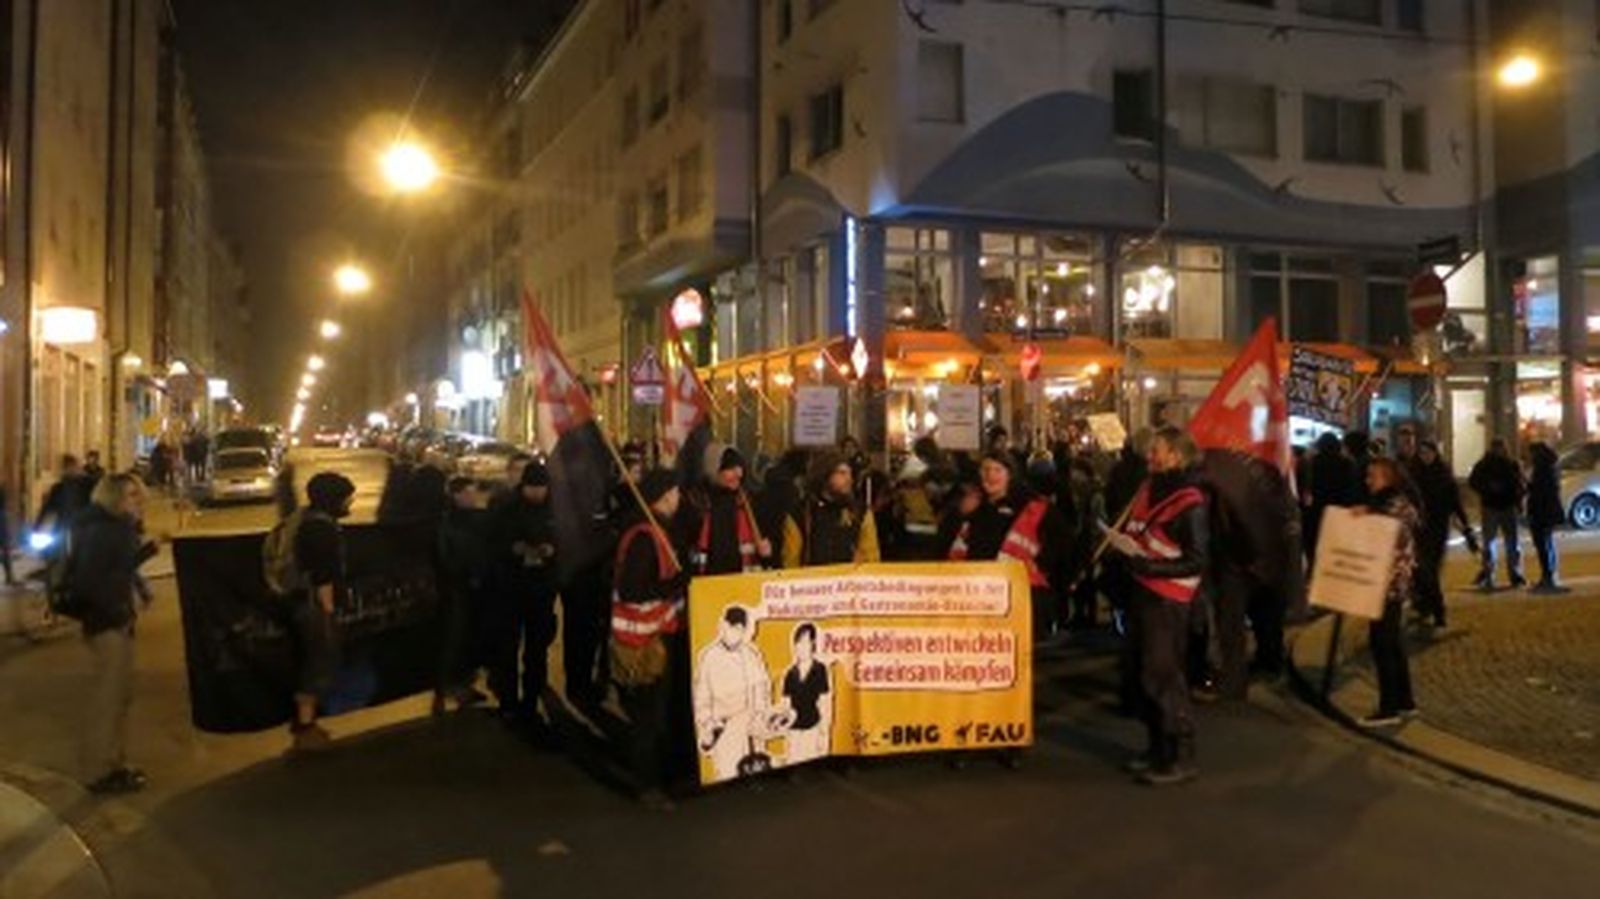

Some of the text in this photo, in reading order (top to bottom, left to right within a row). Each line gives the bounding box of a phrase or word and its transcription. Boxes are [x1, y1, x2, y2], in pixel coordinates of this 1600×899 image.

[824, 633, 1012, 655] Perspektiven entwickeln
[854, 660, 1012, 687] Gemeinsam kämpfen
[975, 723, 1026, 743] FAU
